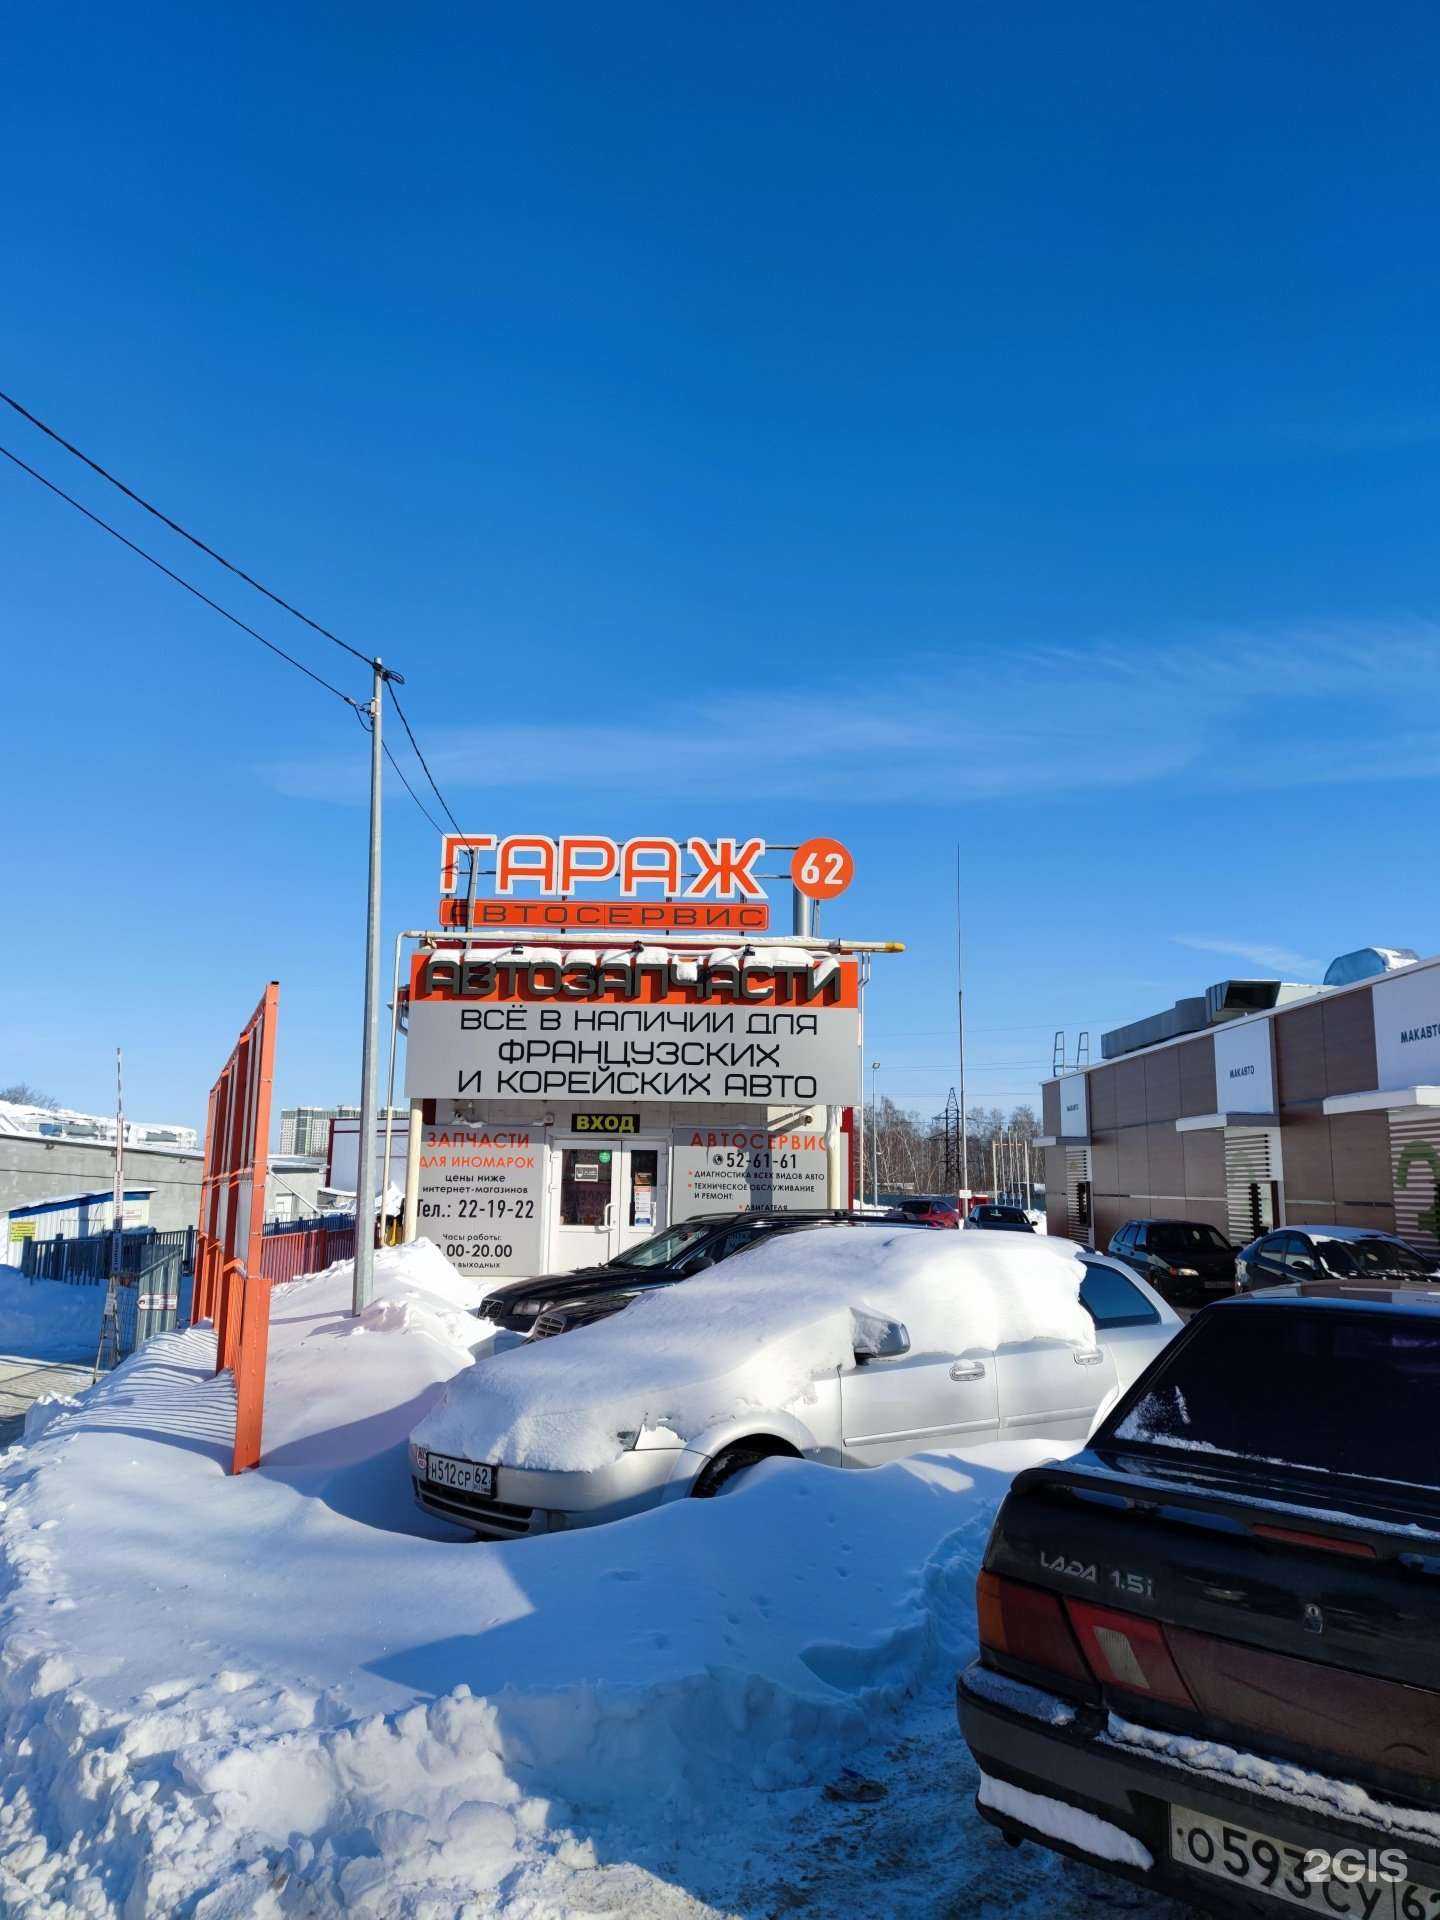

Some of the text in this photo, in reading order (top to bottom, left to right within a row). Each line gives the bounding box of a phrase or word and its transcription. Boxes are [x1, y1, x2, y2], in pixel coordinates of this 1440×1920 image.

[440, 834, 769, 899] ГАРАЖ
[801, 852, 844, 885] 62
[450, 904, 765, 928] АВТОСЕРВИС
[424, 960, 842, 1002] АВТОЗАПЧАСТИ
[460, 1004, 818, 1036] ВСЁ В НАЛИЧИИ ДЛЯ
[498, 1039, 780, 1068] ФРАНЦУЗСКИХ
[458, 1065, 818, 1099] И КОРЕЙСКИХ АВТО
[576, 1115, 635, 1133] ВХОД
[426, 1131, 529, 1149] ЗАПЧАСТИ
[418, 1156, 535, 1169] ДЛЯ ИНОМАРОК
[726, 1152, 797, 1169] 52-61-61
[444, 1174, 506, 1184] цены ниже
[694, 1170, 825, 1181] ДИАГНОСТИКА ВСЕХ ВИДОВ АВТО
[422, 1186, 529, 1198] интернет-магазинов
[694, 1182, 815, 1193] ТЕХНИЧЕСКОЕ ОБСЛУЖИВАНИЕ
[417, 1198, 535, 1219] Тел.: 22-19-22
[744, 1204, 788, 1213] ДВИГАТЕЛЯ
[442, 1233, 465, 1241] Часы
[474, 1467, 488, 1485] 62
[1040, 1551, 1152, 1597] LADA 1.5i
[1402, 1884, 1440, 1920] 6
